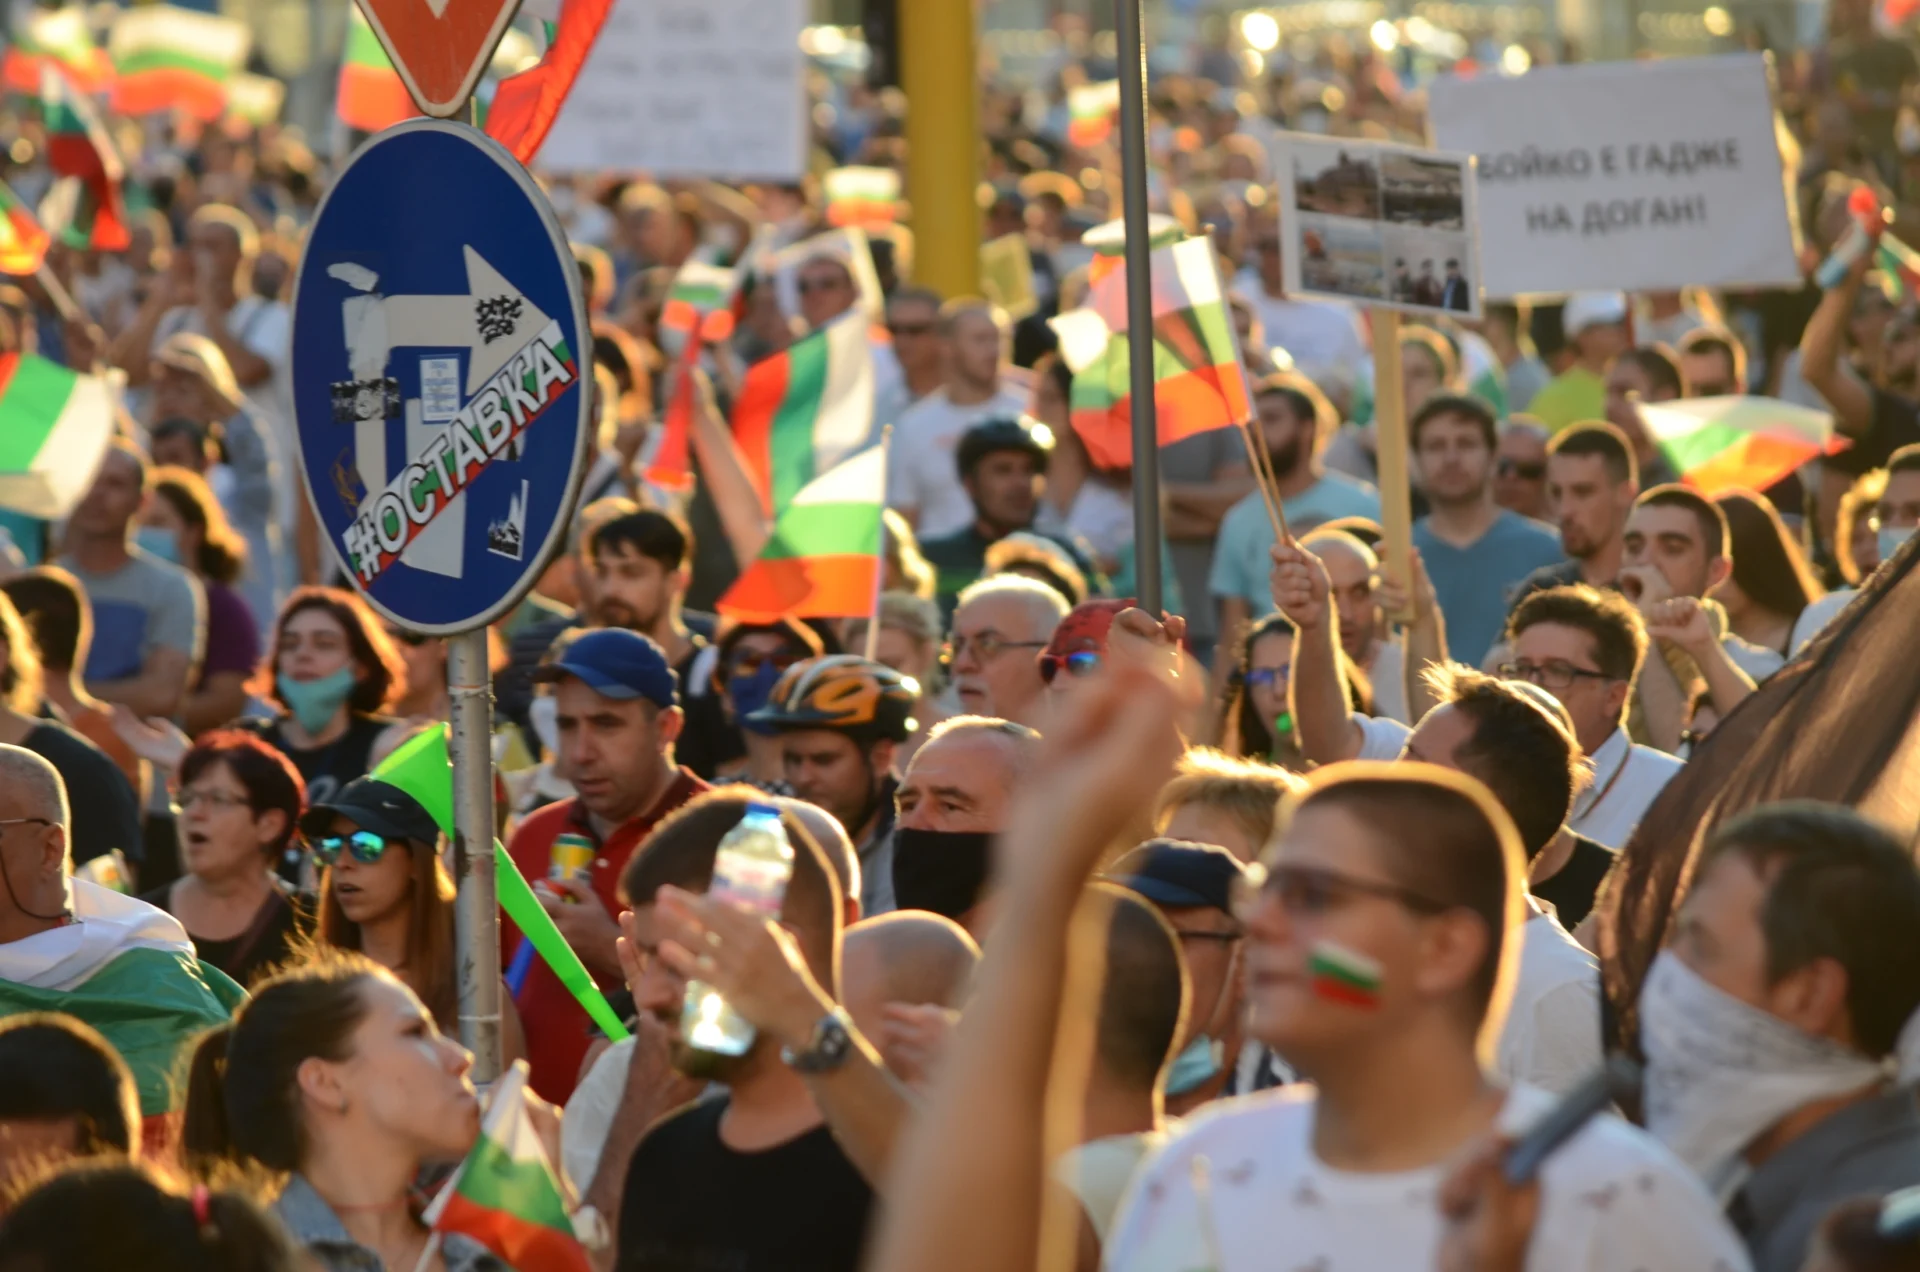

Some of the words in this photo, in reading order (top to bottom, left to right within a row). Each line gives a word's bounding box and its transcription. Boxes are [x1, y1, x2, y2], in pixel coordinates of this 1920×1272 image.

[1601, 145, 1620, 178] Е
[1627, 138, 1742, 176] ГАДЖЕ
[1525, 203, 1574, 235] НА
[1581, 195, 1707, 237] ДОГАН!
[348, 337, 571, 581] #ОСТАВКА
